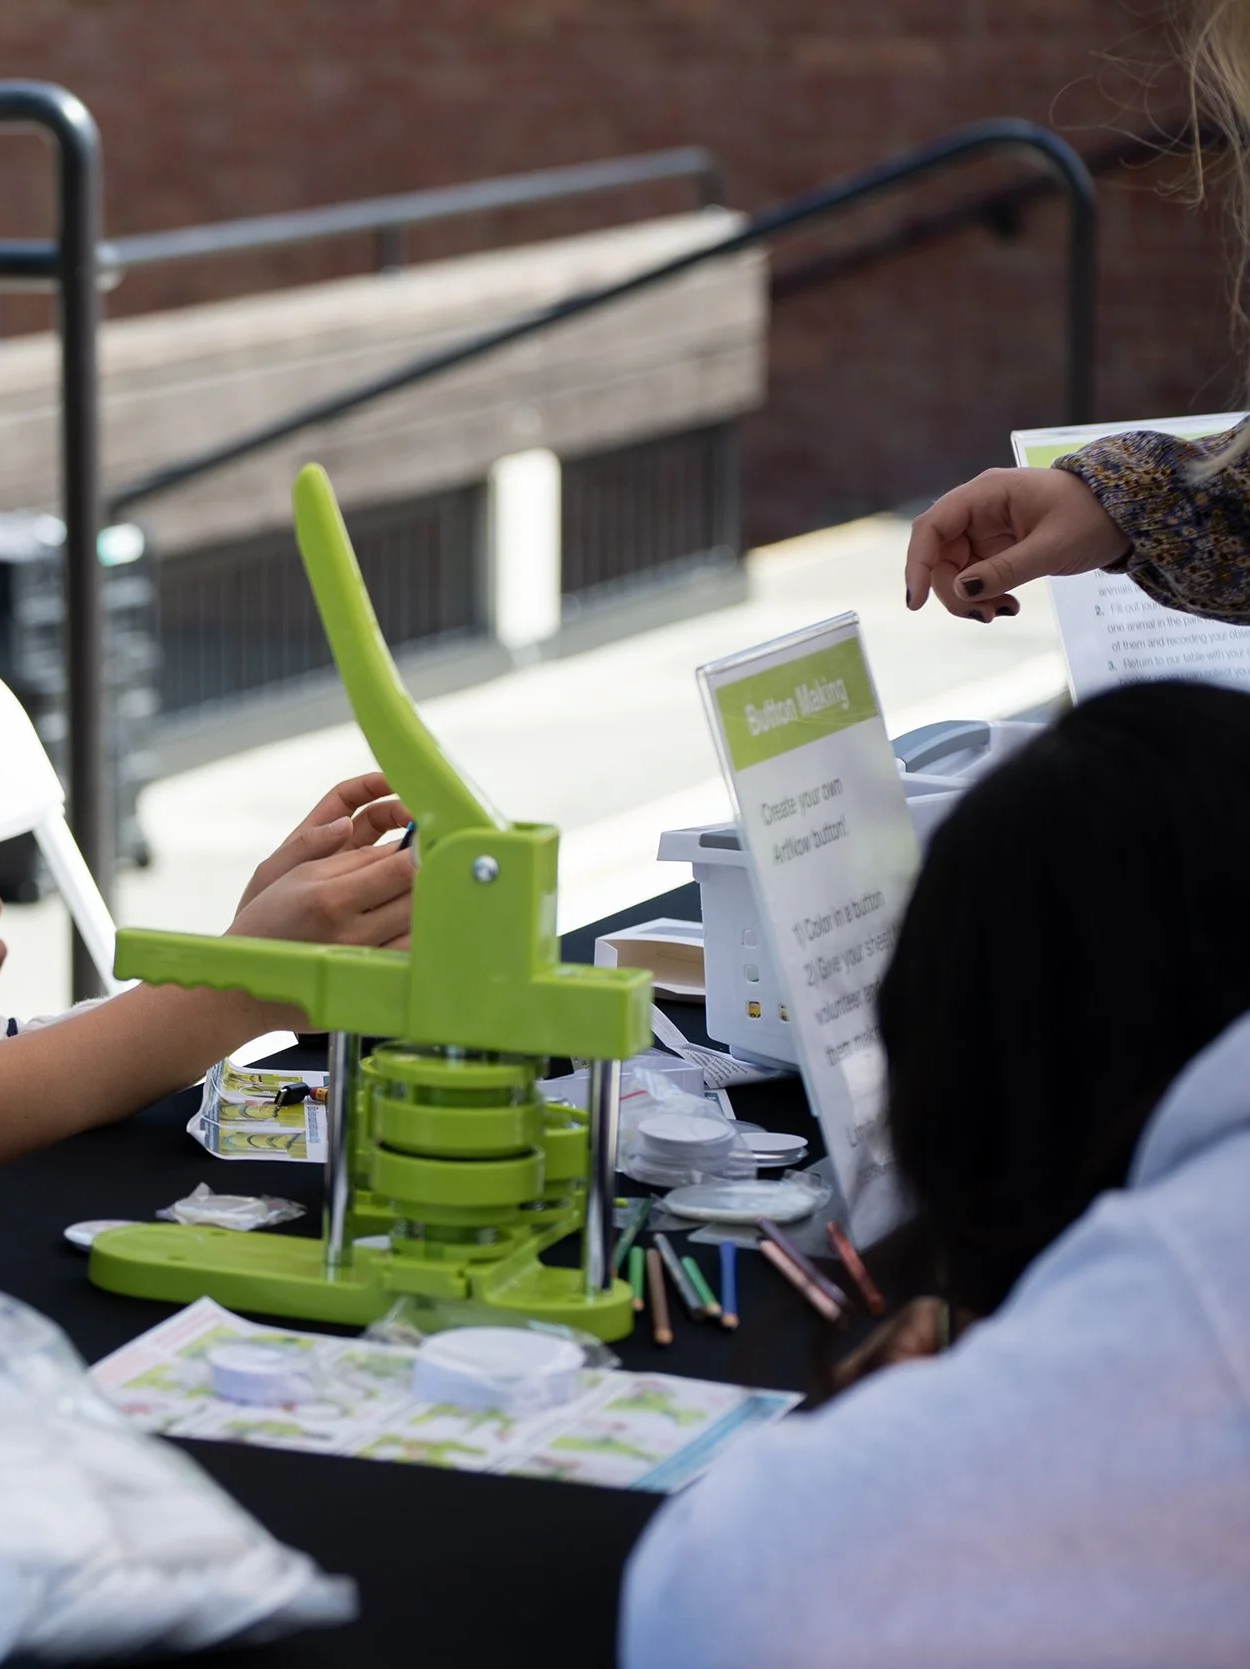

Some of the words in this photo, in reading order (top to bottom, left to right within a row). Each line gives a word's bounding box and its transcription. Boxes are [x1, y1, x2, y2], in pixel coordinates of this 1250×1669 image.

[1107, 623, 1124, 634] one
[1127, 618, 1155, 631] animal
[1157, 617, 1166, 628] in
[1167, 615, 1182, 628] the
[1125, 600, 1140, 613] out
[1111, 640, 1121, 652] of
[1122, 637, 1146, 650] them
[1147, 635, 1165, 648] and
[1166, 631, 1207, 647] recording
[1209, 630, 1228, 643] your
[1122, 656, 1153, 670] Return
[1154, 655, 1165, 667] to
[1166, 654, 1181, 666] our
[1182, 649, 1205, 664] table
[1206, 647, 1225, 661] with
[1226, 646, 1246, 660] your
[744, 698, 798, 736] Button
[795, 677, 849, 712] Making
[761, 797, 797, 825] Create
[798, 786, 822, 816] your
[822, 778, 844, 800] own
[803, 912, 834, 941] Color
[833, 906, 846, 928] in
[851, 890, 885, 918] button
[817, 954, 843, 980] Give
[841, 943, 864, 976] your
[815, 989, 863, 1027] volunteer
